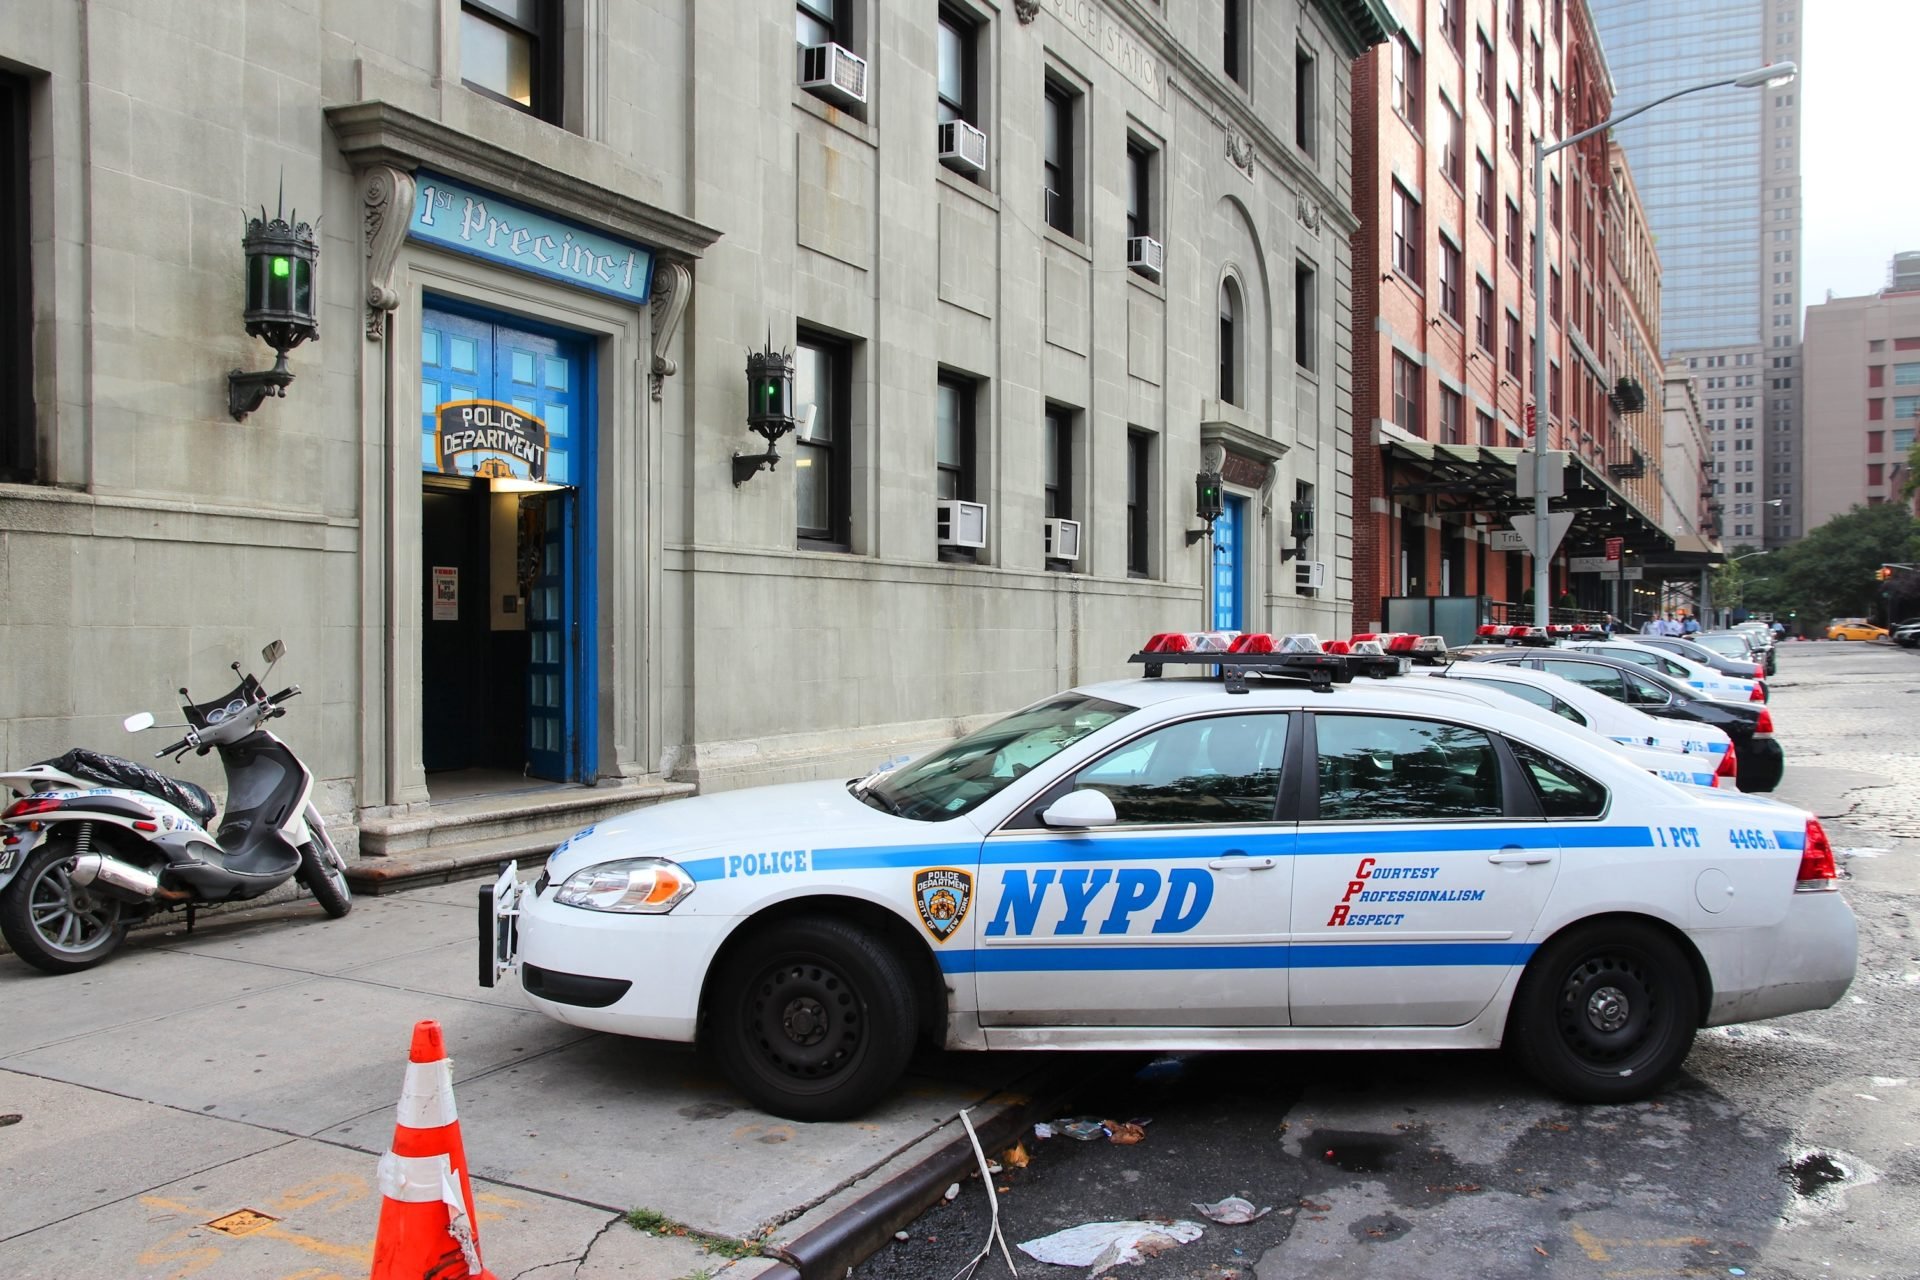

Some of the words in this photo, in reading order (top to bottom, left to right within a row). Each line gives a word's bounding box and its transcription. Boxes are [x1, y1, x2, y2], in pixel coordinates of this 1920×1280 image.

[1052, 0, 1095, 37] LICE
[1106, 26, 1161, 100] STATION
[420, 186, 454, 226] 1ST
[459, 196, 639, 289] Precinct
[462, 407, 524, 435] POLICE
[443, 429, 544, 465] DEPARTMENT
[1502, 533, 1523, 542] TriB
[1669, 826, 1701, 848] PCT
[1729, 828, 1767, 850] 4466
[0, 850, 16, 870] 21
[729, 850, 807, 878] POLICE
[917, 879, 970, 892] DEPARTMENT
[928, 871, 960, 881] POLICE
[918, 900, 929, 918] CITY
[926, 920, 937, 930] OF
[946, 918, 960, 934] NEW
[957, 896, 970, 916] YORK
[984, 868, 1214, 936] NYPD
